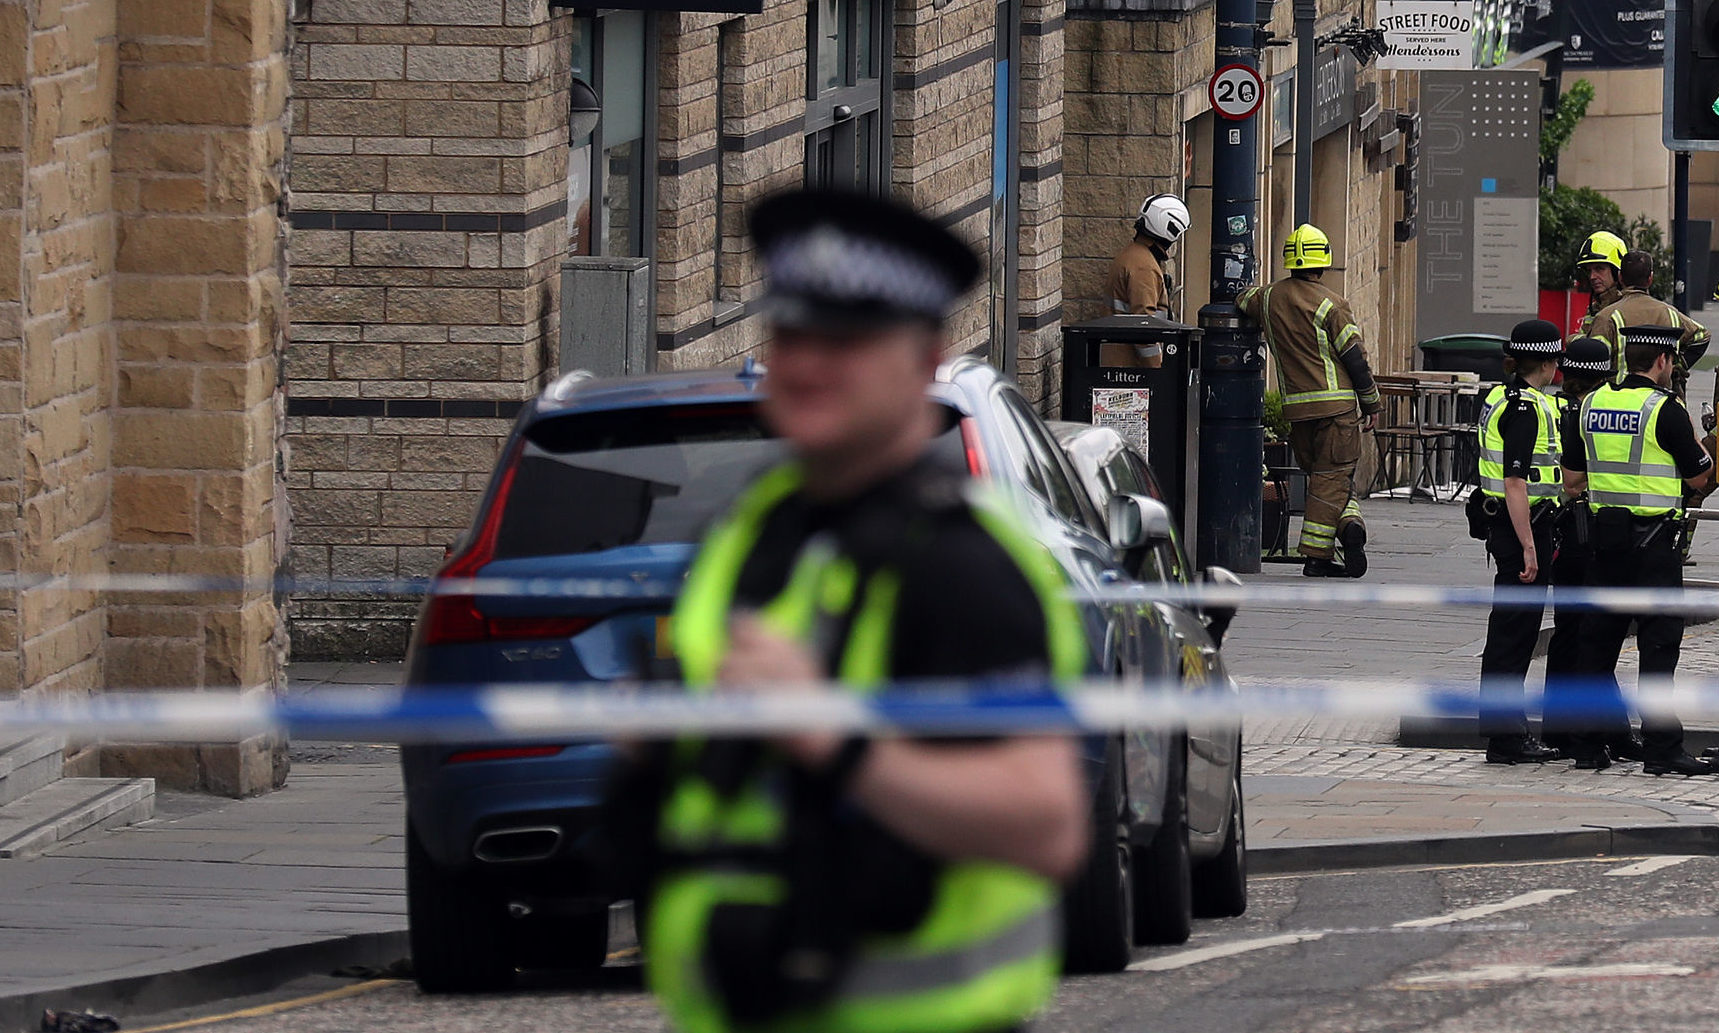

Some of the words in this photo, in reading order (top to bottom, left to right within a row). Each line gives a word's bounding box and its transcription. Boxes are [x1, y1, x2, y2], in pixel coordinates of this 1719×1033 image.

[1379, 13, 1428, 33] STREET
[1431, 14, 1471, 33] FOOD
[1217, 80, 1256, 103] 20
[1427, 83, 1465, 188] TUN
[1107, 371, 1141, 383] Litter
[1588, 412, 1638, 431] POLICE
